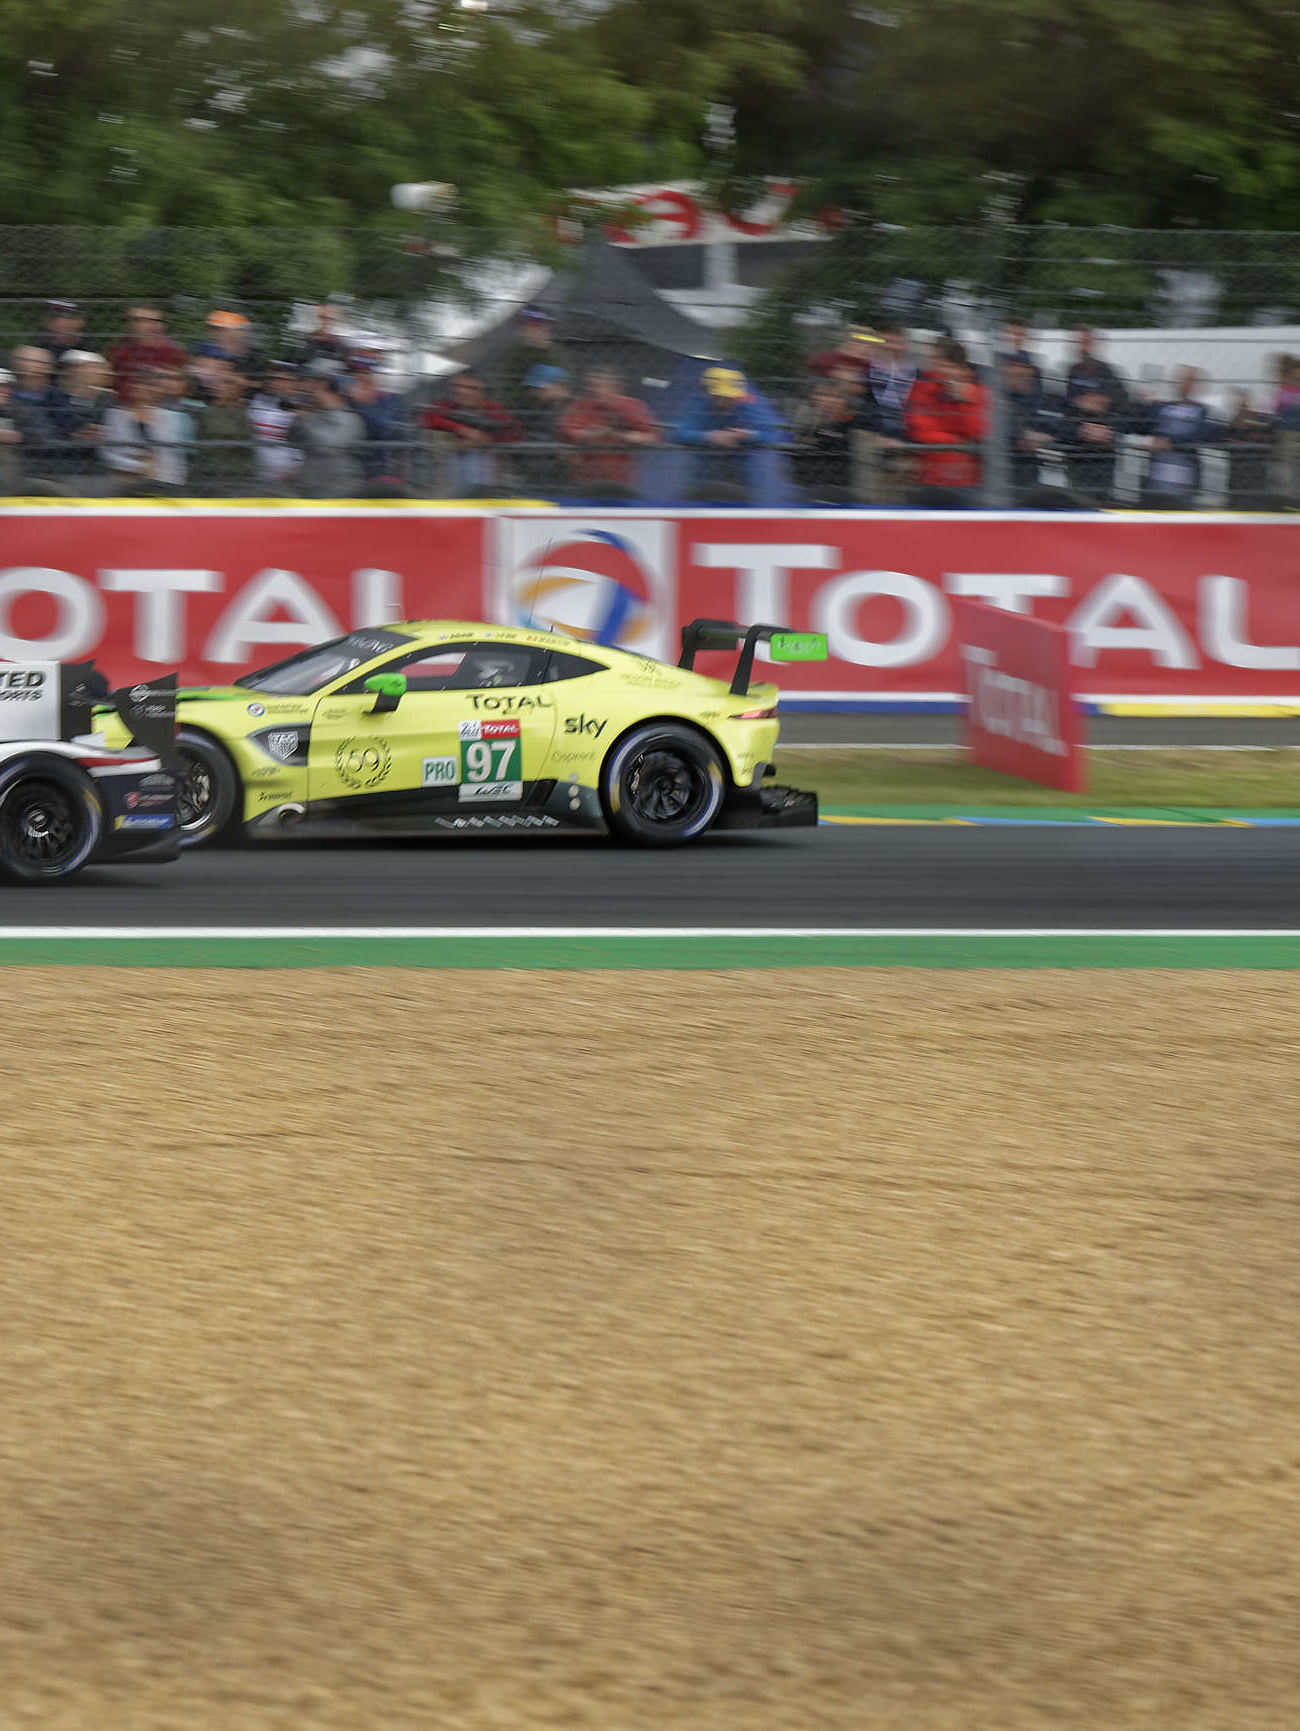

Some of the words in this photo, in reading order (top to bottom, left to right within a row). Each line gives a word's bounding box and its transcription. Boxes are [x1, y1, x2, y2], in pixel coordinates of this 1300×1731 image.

[466, 693, 552, 712] TOTAL
[482, 723, 520, 736] TOTAL
[564, 713, 609, 739] sky
[424, 760, 456, 782] PRO
[465, 740, 517, 783] 97
[474, 783, 515, 796] WEC
